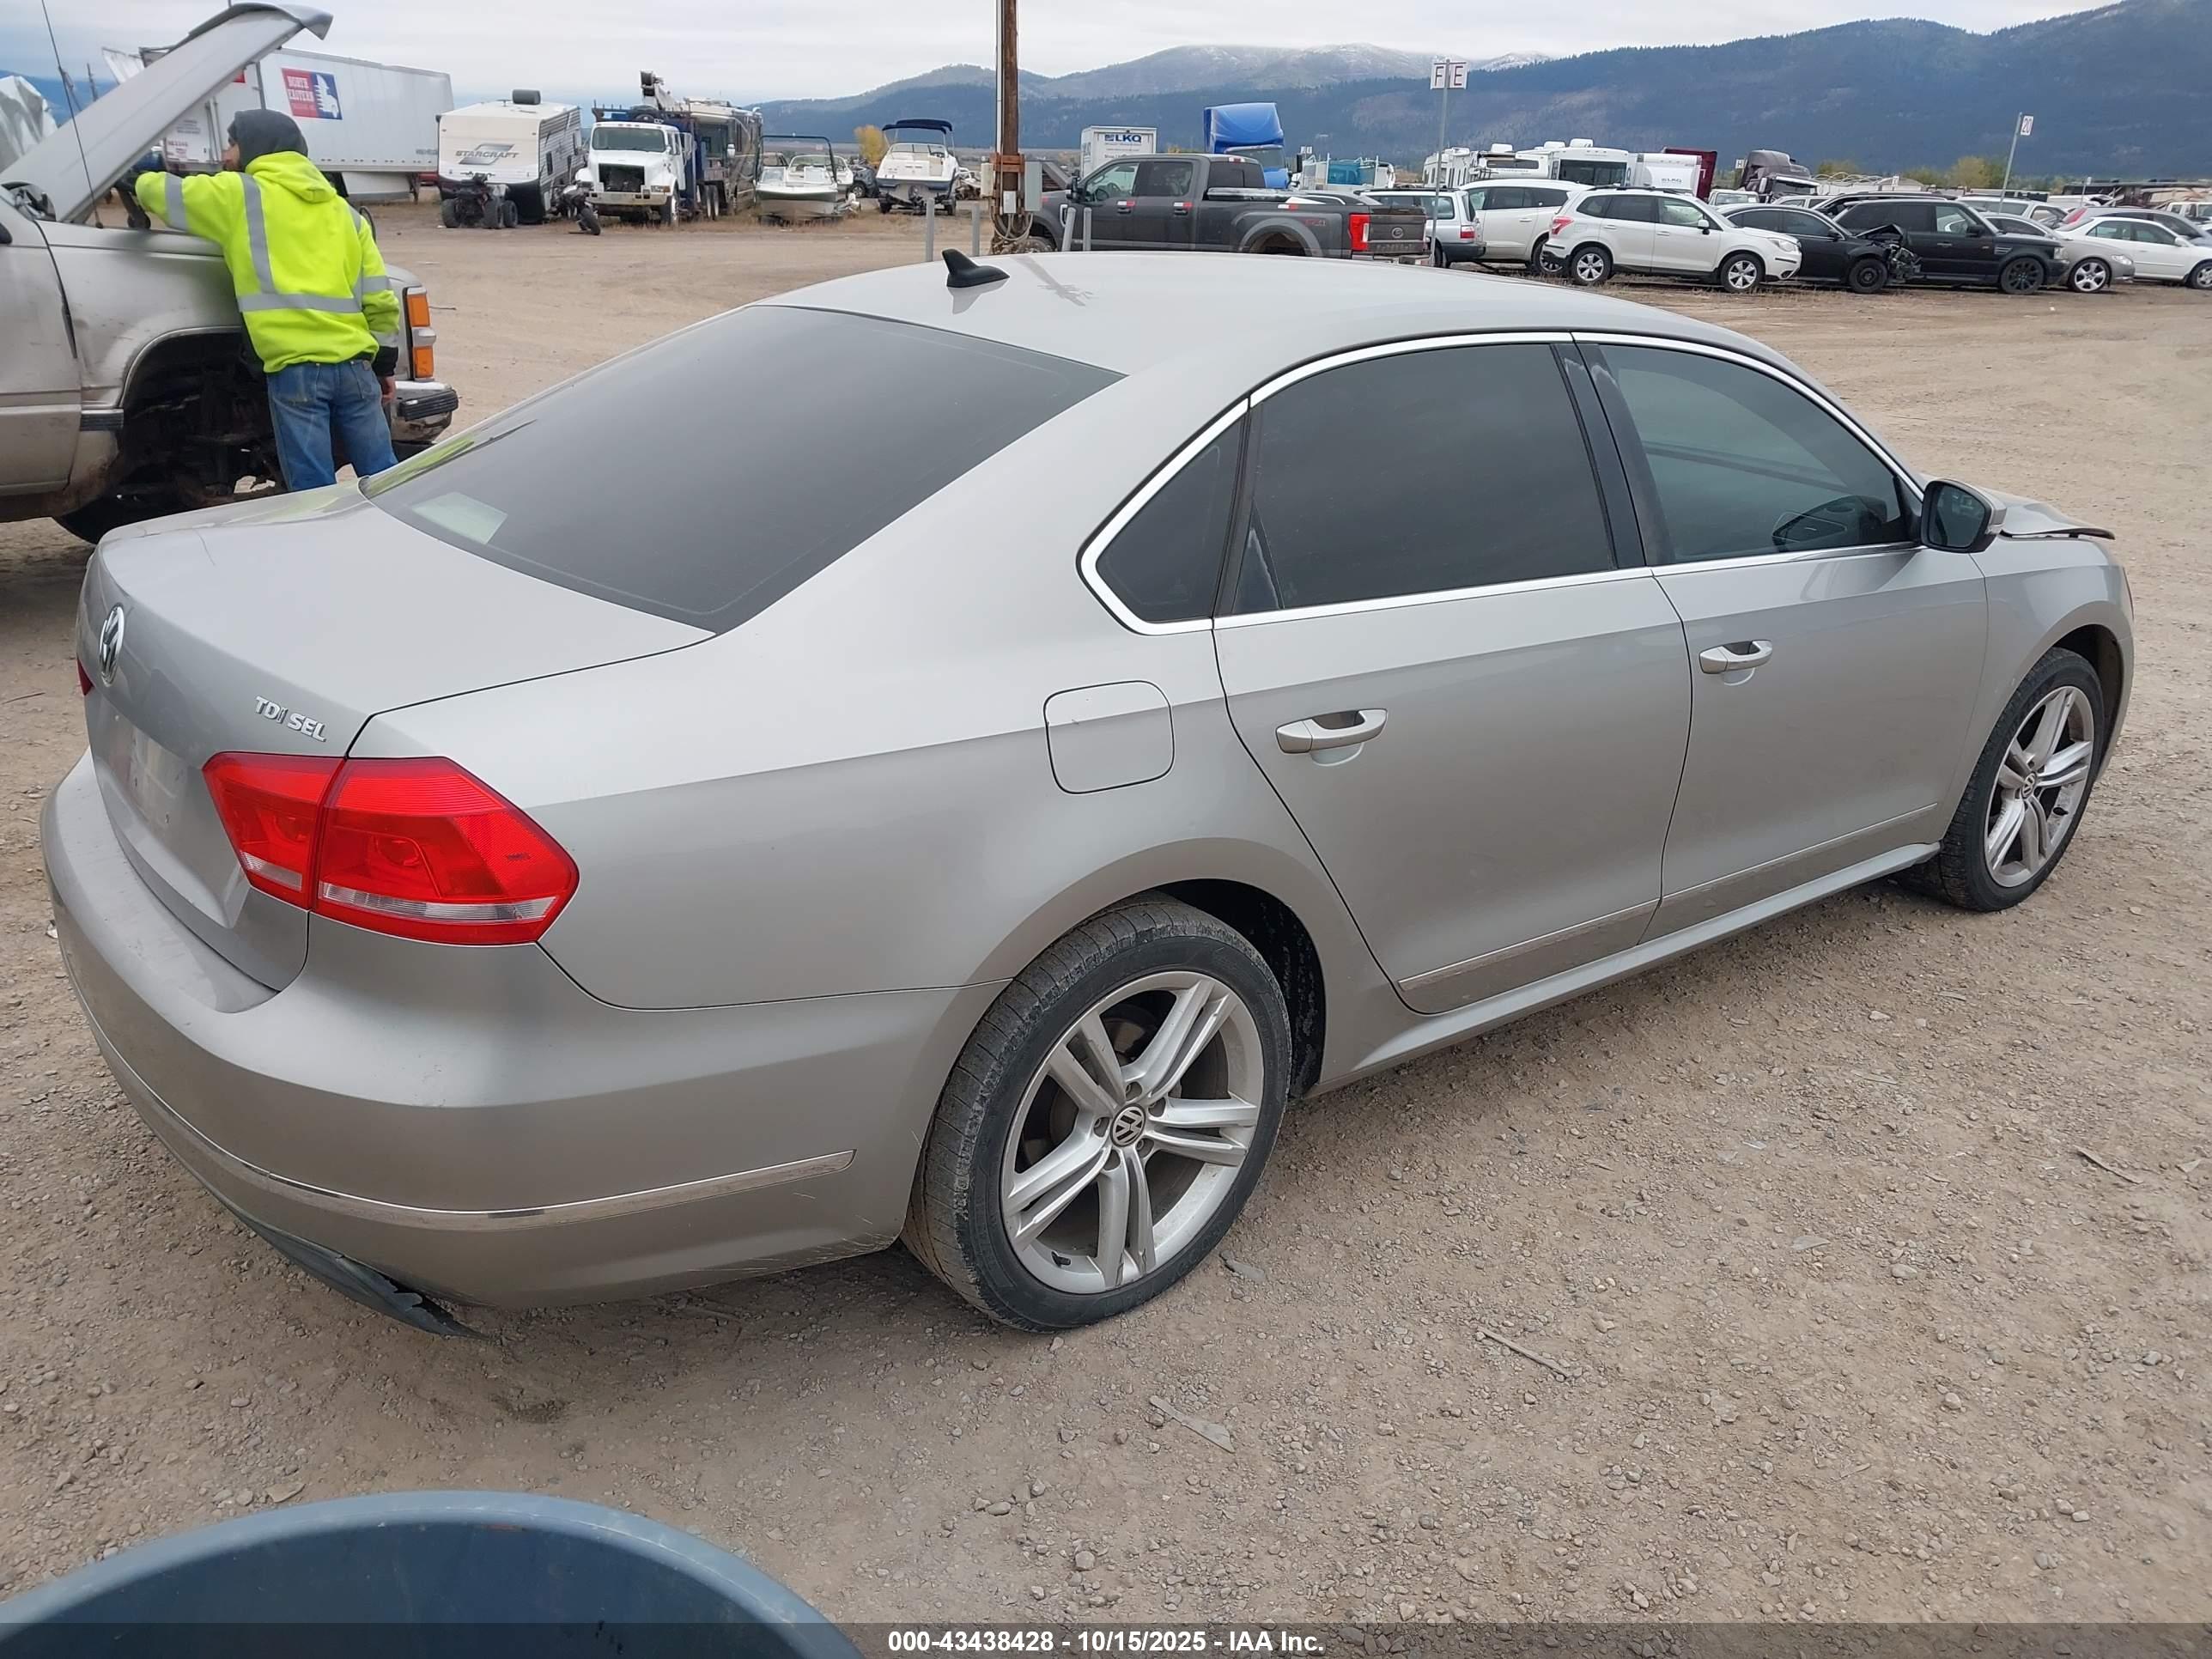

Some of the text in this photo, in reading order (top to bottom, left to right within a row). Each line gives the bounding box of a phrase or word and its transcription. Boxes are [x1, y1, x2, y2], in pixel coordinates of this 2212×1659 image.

[1435, 66, 1443, 86] F
[1454, 65, 1463, 86] E
[2022, 118, 2033, 133] 20
[1115, 134, 1141, 143] LKQ
[255, 696, 326, 742] TDI SEL
